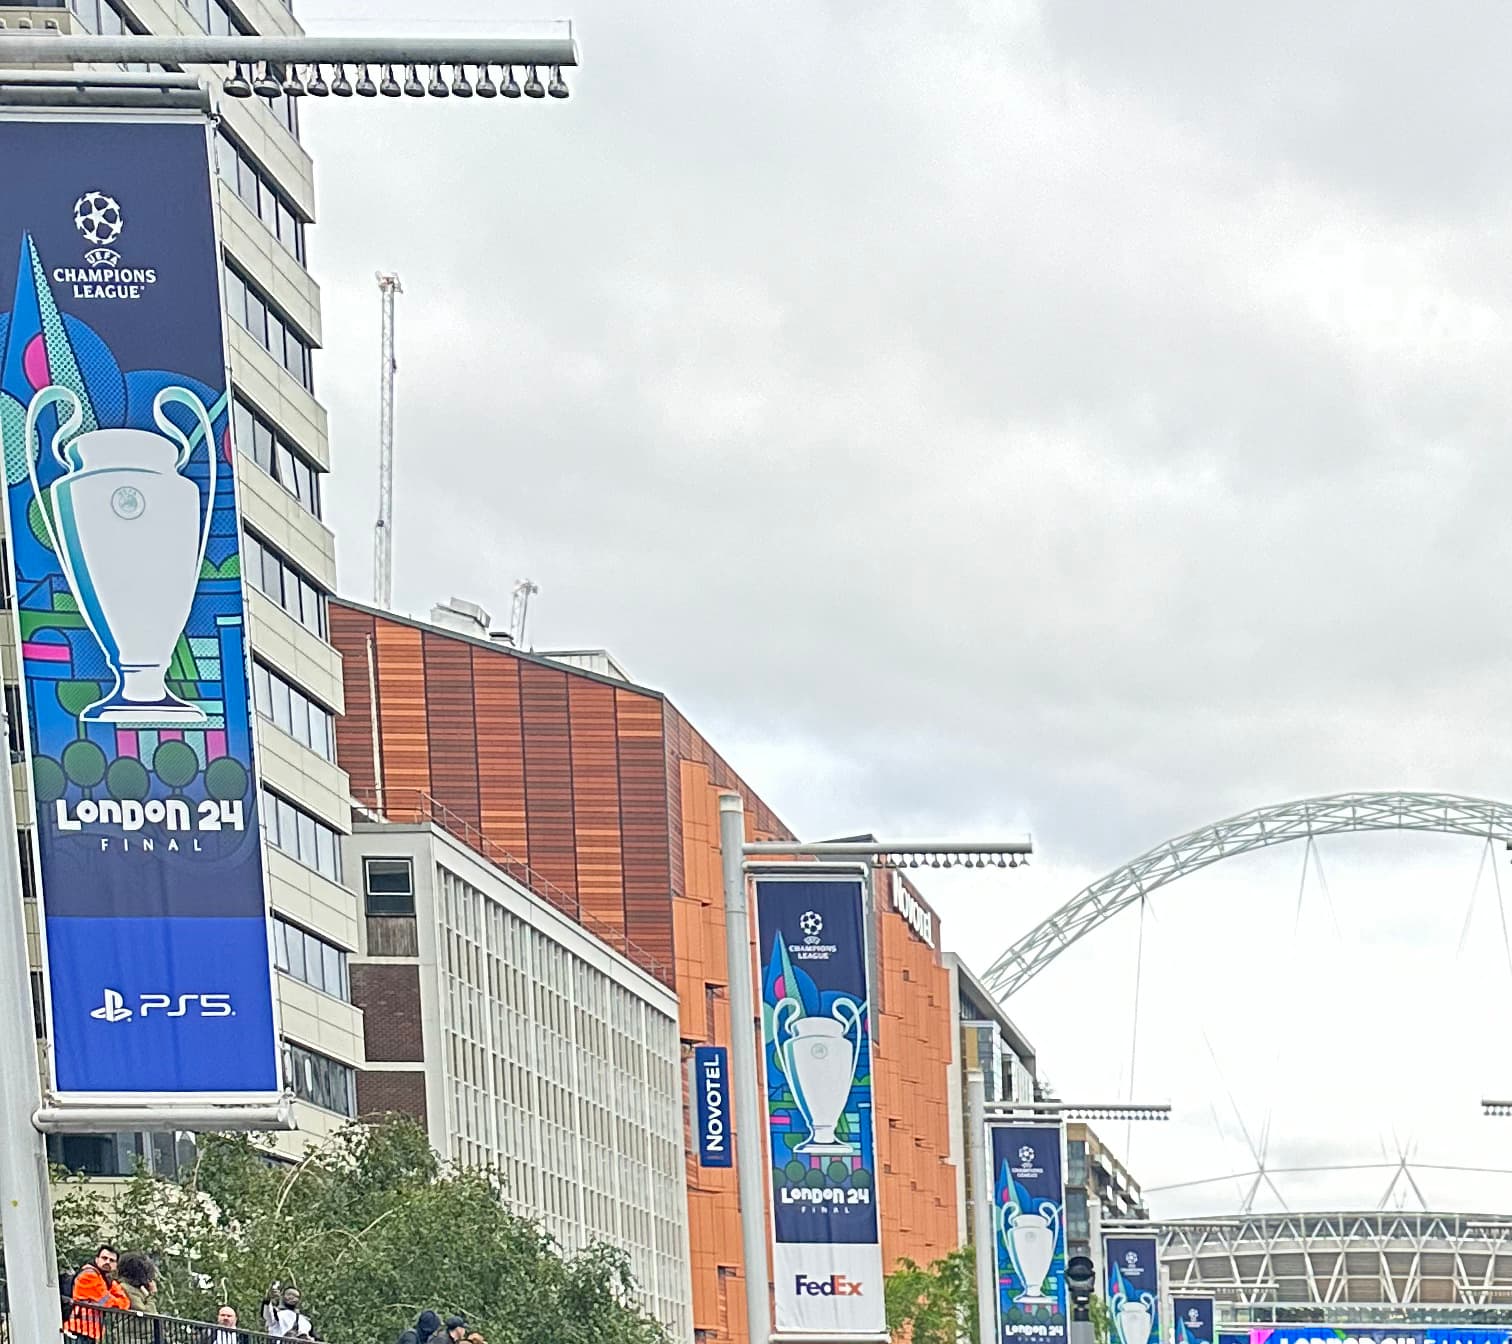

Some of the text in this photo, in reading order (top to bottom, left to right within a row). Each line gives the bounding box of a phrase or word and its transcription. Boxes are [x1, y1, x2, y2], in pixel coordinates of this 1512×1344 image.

[86, 251, 118, 265] UEFA
[53, 268, 157, 283] CHAMPIONS
[73, 284, 141, 298] LEAGUE
[198, 800, 244, 831] 24
[101, 838, 202, 852] FINAL
[139, 994, 231, 1017] PS5
[704, 1054, 724, 1152] NOVOTEL
[847, 1188, 870, 1204] 24
[795, 1275, 863, 1296] FedEx
